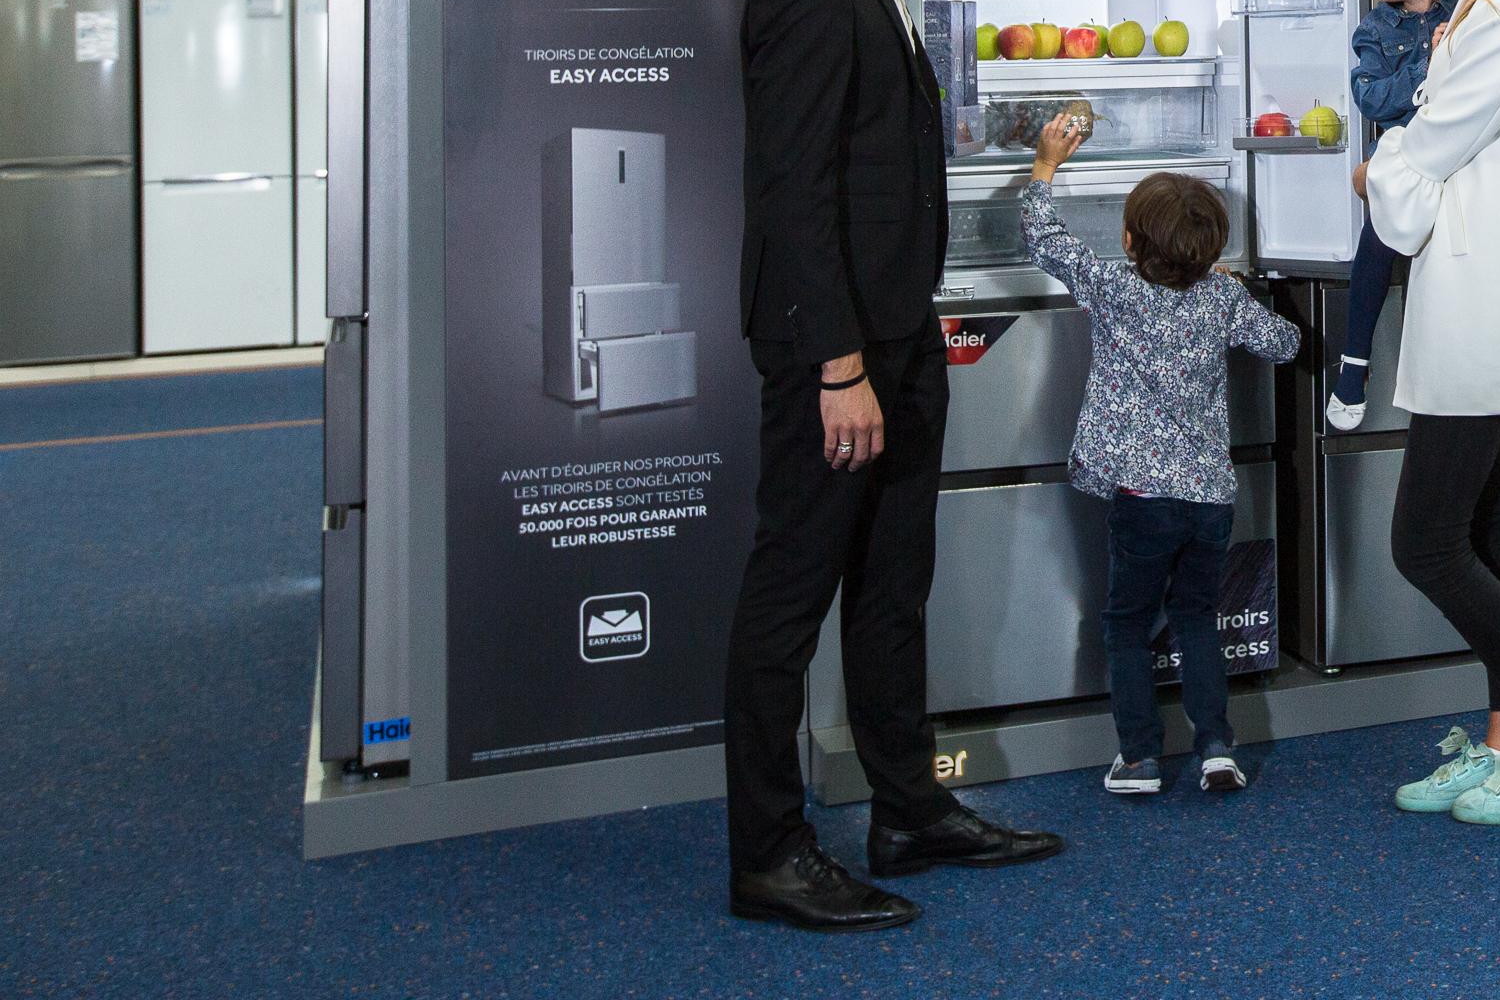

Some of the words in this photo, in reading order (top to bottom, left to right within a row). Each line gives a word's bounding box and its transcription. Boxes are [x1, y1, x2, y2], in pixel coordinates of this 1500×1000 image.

[525, 49, 575, 61] TIROIRS
[578, 49, 596, 60] DE
[599, 45, 694, 60] CONGÉLATION
[550, 68, 596, 84] EASY
[599, 67, 669, 83] ACCESS
[501, 467, 548, 482] AVANT
[551, 461, 621, 478] D'ÉQUIPER
[624, 458, 652, 471] NOS
[514, 486, 539, 499] LES
[542, 481, 593, 496] TIROIRS
[595, 479, 613, 491] DE
[616, 471, 711, 489] CONGÉLATION
[522, 502, 557, 516] EASY
[560, 496, 613, 512] ACCESS
[616, 493, 653, 507] SONT
[656, 487, 704, 503] TESTÉS
[519, 519, 564, 534] 50.000
[566, 515, 597, 529] FOIS
[600, 512, 637, 526] POUR
[640, 505, 707, 522] GARANTIR
[552, 534, 586, 548] LEUR
[589, 525, 676, 545] ROBUSTESSE
[1216, 608, 1269, 631] iroirs
[589, 637, 609, 646] EASY
[610, 633, 642, 644] ACCESS
[1152, 651, 1183, 669] as
[1221, 640, 1270, 659] cess
[935, 750, 967, 778] er
